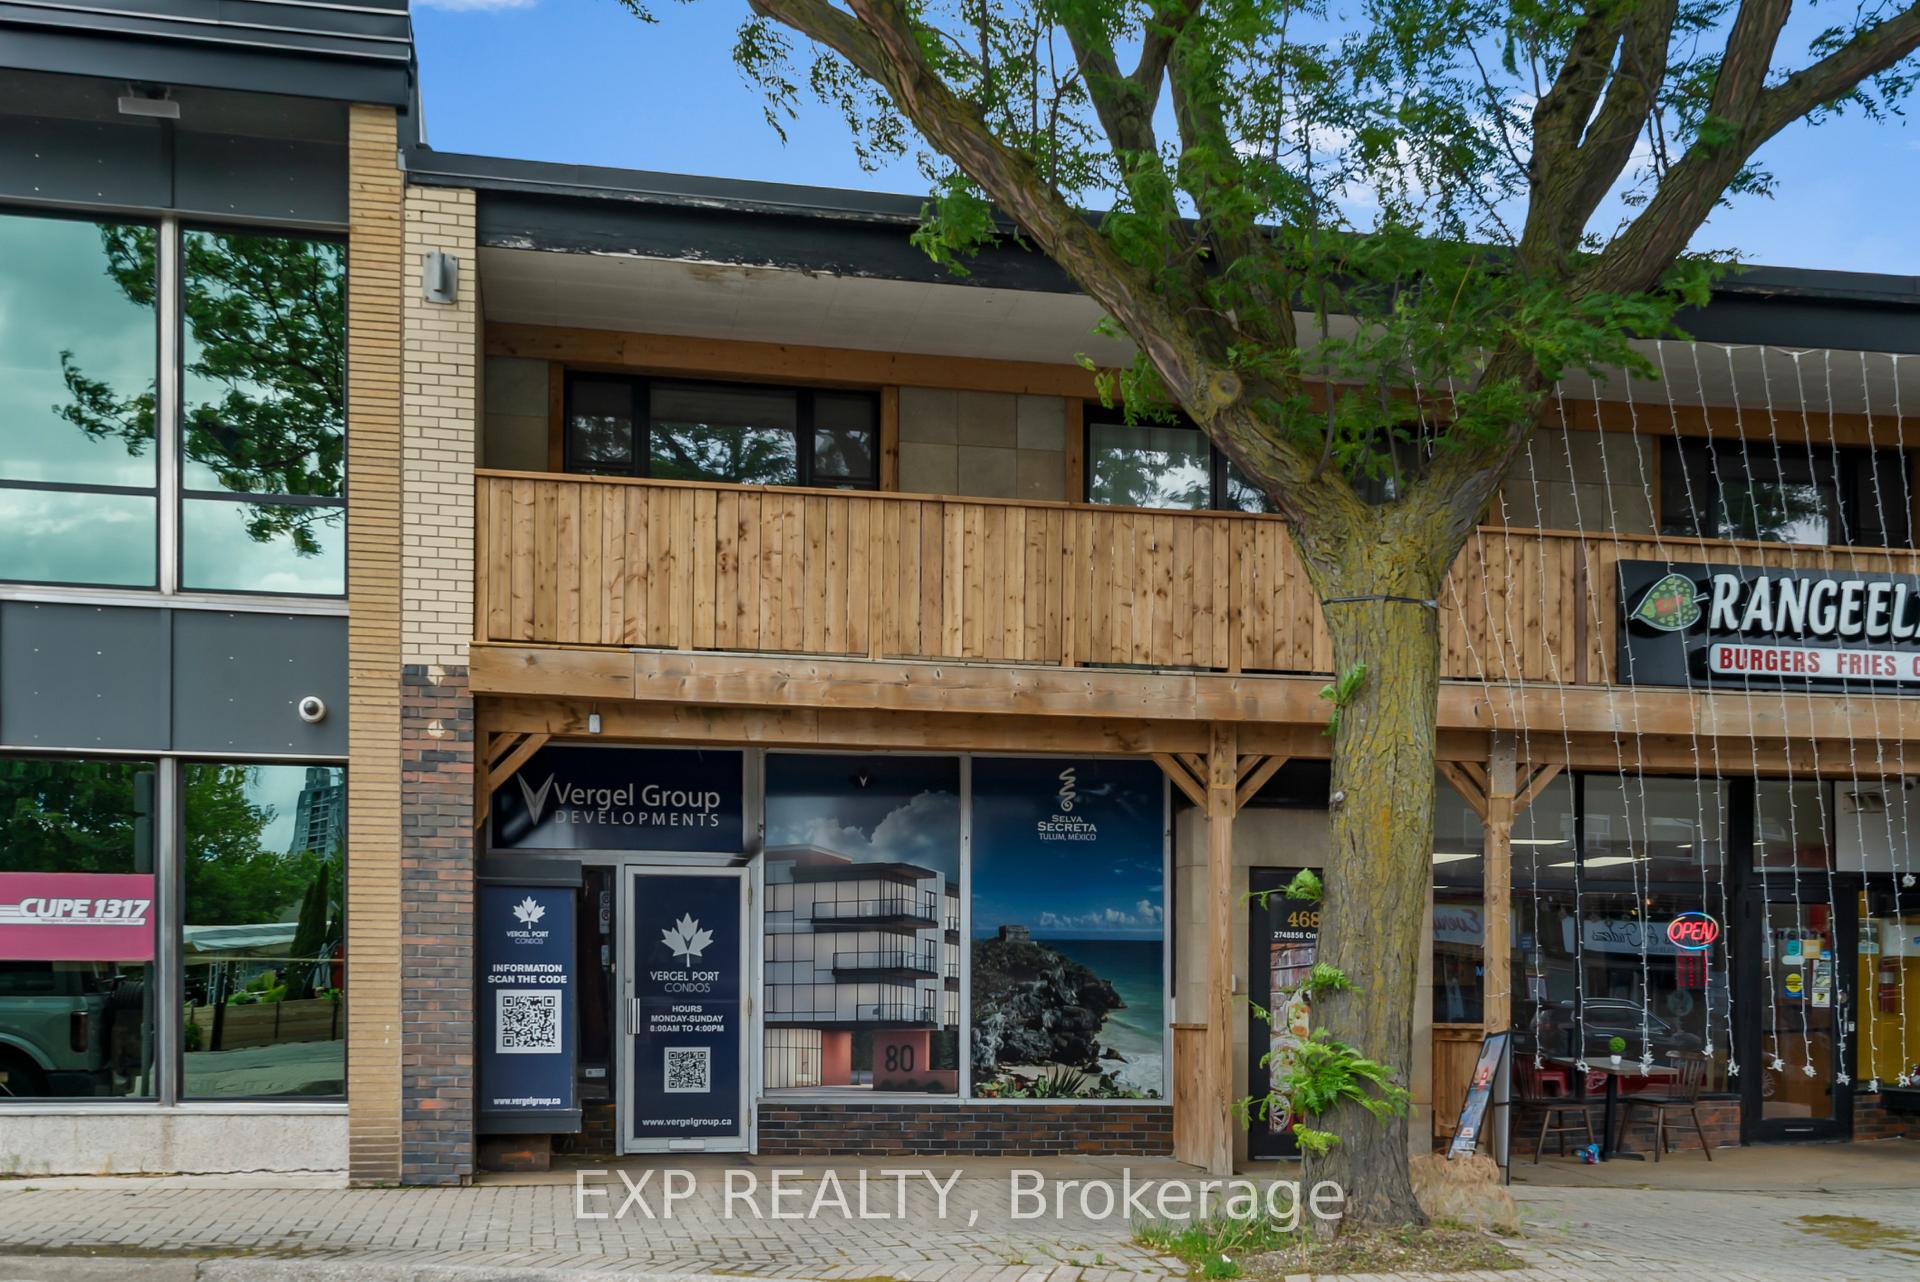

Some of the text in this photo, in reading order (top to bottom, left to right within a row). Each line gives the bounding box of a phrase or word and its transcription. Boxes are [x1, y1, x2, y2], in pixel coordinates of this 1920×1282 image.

[1710, 574, 1920, 639] RANGEEL
[1720, 648, 1820, 673] BURGERS
[1837, 653, 1896, 676] FRIES
[554, 782, 720, 813] Vergel Group
[555, 810, 719, 827] DEVELOPMENTS
[1037, 821, 1097, 832] SECRETA
[19, 898, 151, 918] CUPE 1317
[1287, 911, 1321, 928] 468
[1305, 932, 1319, 940] On
[1670, 921, 1715, 942] OPEN
[492, 964, 563, 973] INFORMATION
[488, 975, 568, 984] SCAN THE CODE
[650, 971, 720, 982] VERGEL PORT
[664, 982, 711, 993] CONDOS
[672, 1005, 703, 1013] HOURS
[650, 1015, 724, 1023] MONDAY-SUNDAY
[884, 1044, 915, 1073] 80
[493, 1096, 562, 1106] www.vergelgroup.ca
[641, 1117, 733, 1128] www.vergelgroup.ca
